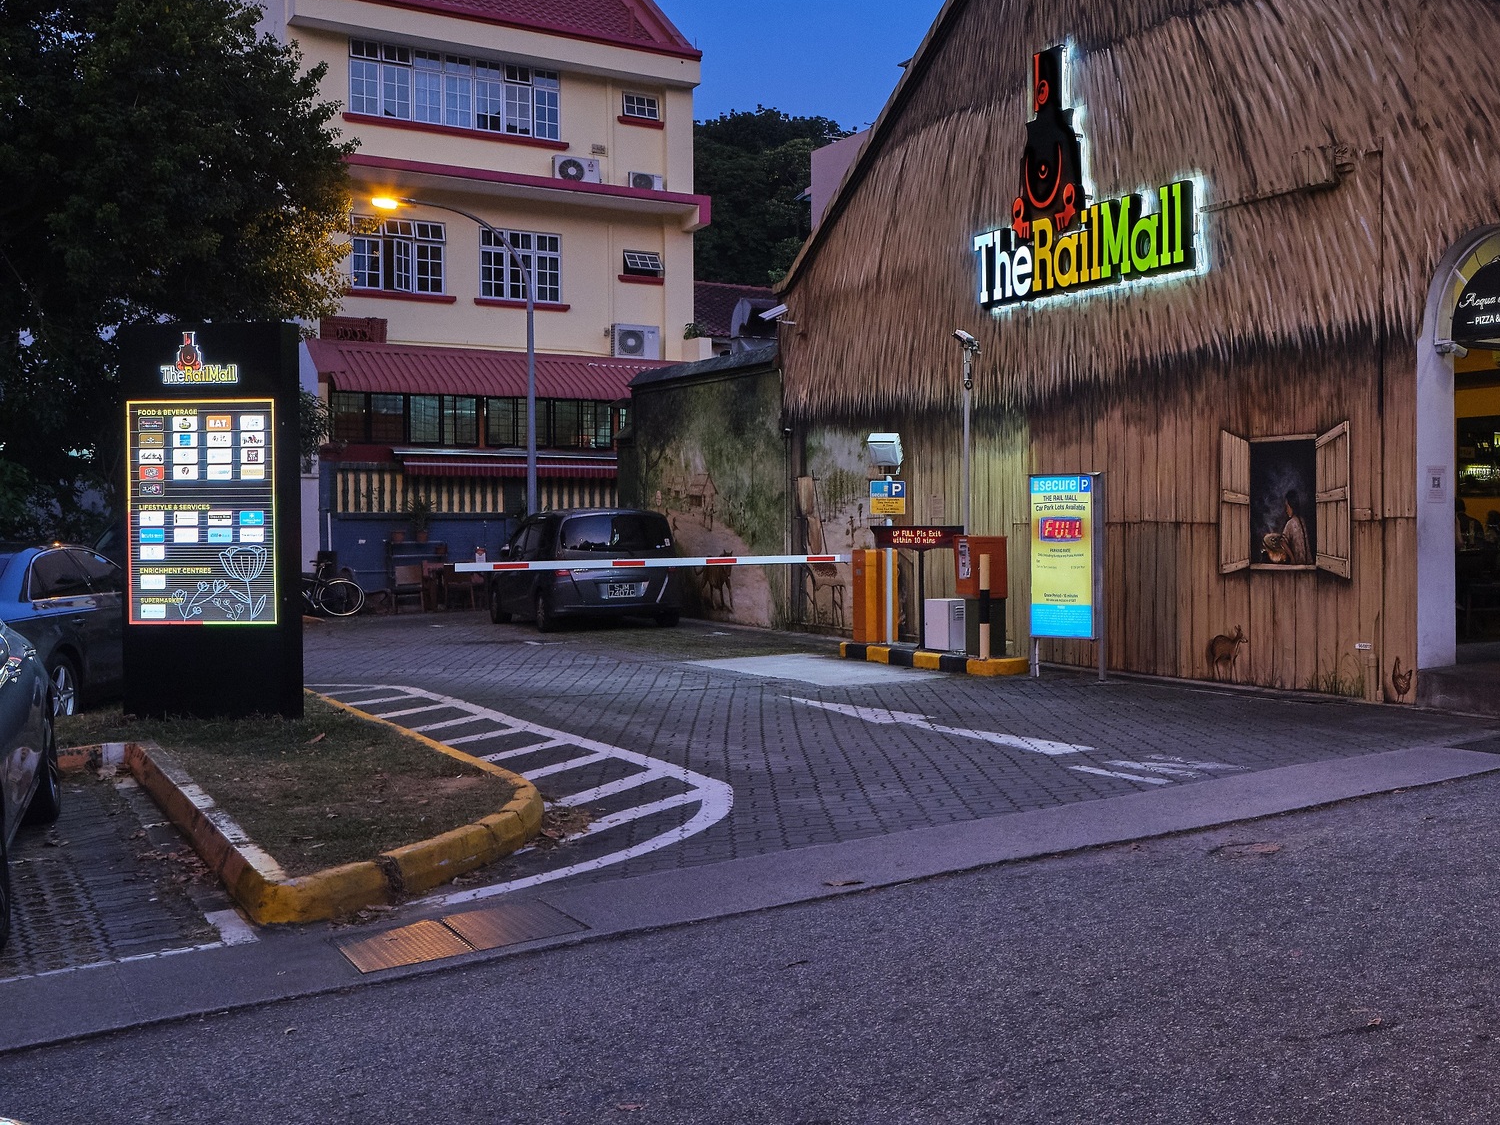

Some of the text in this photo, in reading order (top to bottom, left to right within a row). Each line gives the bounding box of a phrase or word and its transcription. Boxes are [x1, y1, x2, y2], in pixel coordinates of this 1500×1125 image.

[1459, 292, 1496, 310] Acqua
[1475, 315, 1494, 325] PIZZA
[1495, 314, 1500, 323] &
[892, 483, 902, 496] P
[1040, 479, 1089, 491] secure P
[1044, 519, 1082, 538] FULL
